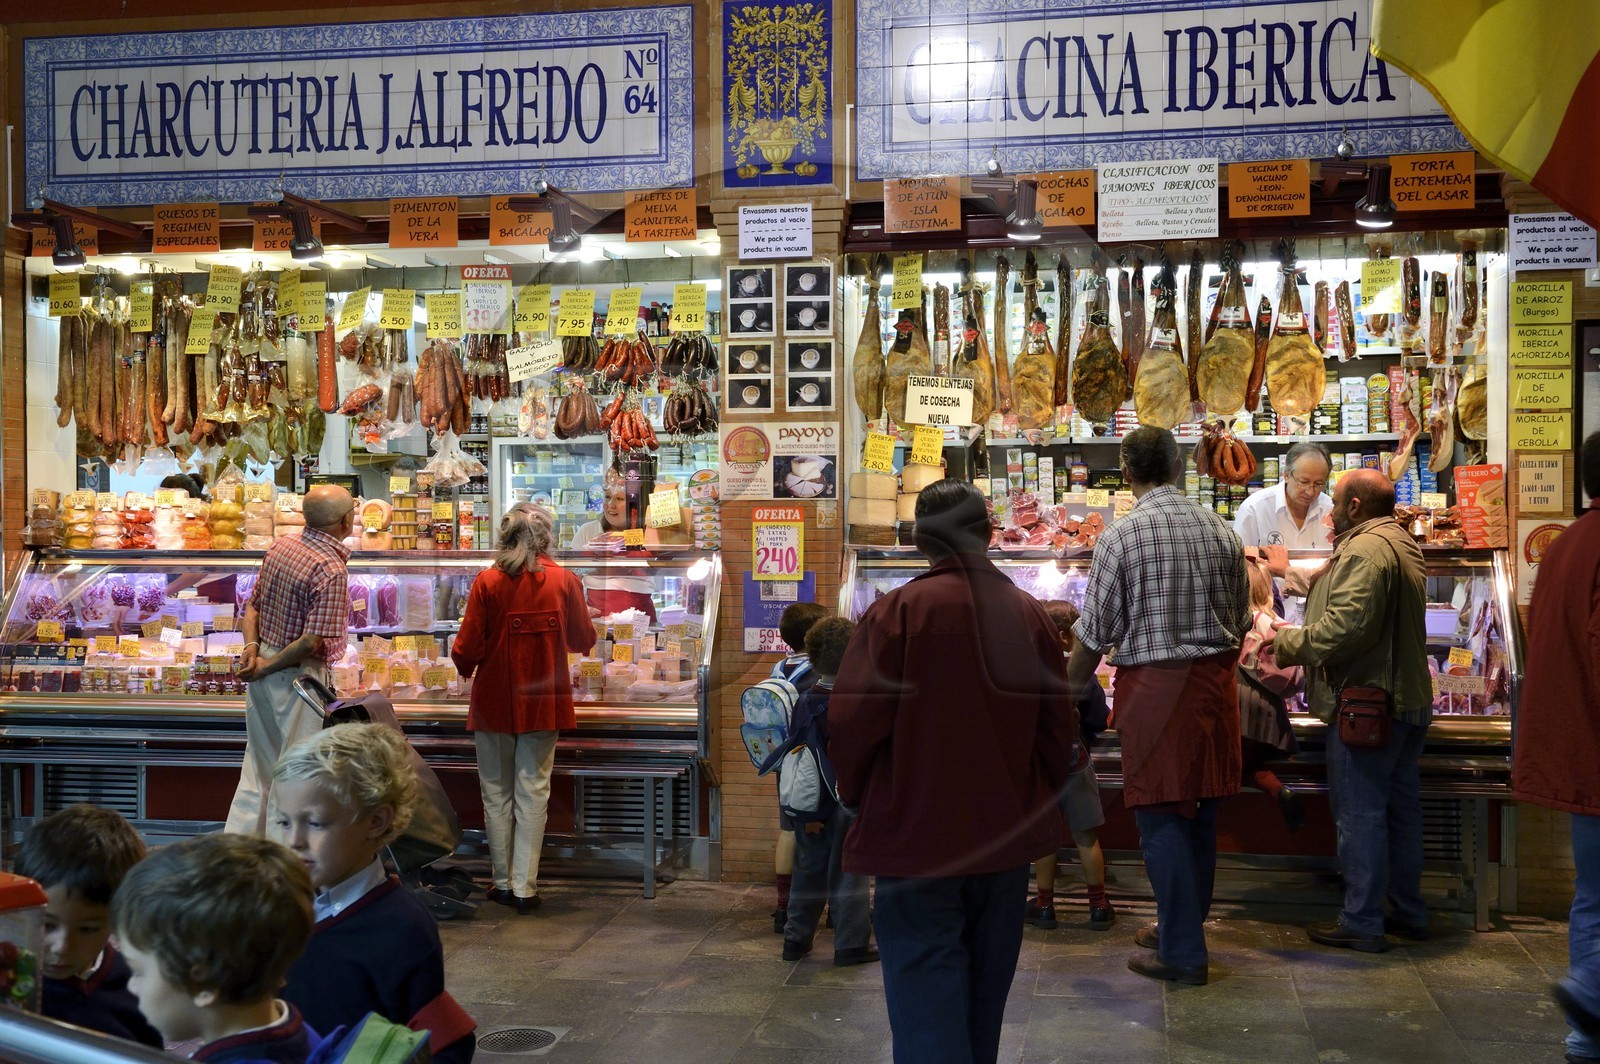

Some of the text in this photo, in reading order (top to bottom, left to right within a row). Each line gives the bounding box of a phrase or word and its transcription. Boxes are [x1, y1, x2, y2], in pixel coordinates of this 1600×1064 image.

[1164, 11, 1396, 116] IBERICA
[623, 81, 658, 114] 64
[70, 61, 607, 162] CHARCUTERIA J.ALFREDO
[1103, 163, 1216, 179] CLASIFICACION DE
[1247, 163, 1294, 174] CECINA DE
[1409, 160, 1456, 172] TORTA
[898, 177, 948, 190] MOJAMA
[1252, 174, 1289, 182] VACUNO
[1393, 172, 1473, 188] EXTREMEÑA
[1100, 179, 1217, 195] JAMONES IBERICOS
[634, 190, 690, 203] FILETES DE
[898, 191, 948, 203] DE ATUN
[1047, 193, 1065, 204] DE
[1135, 193, 1212, 206] ALIMENTACION
[1235, 192, 1307, 203] DENOMINACION
[1396, 189, 1470, 202] DEL CASAR
[393, 202, 457, 213] PIMENTON
[645, 204, 678, 213] MELVA
[742, 206, 809, 215] Envasamos nuestros
[1101, 210, 1125, 218] Bellota
[1194, 206, 1217, 214] Pastos
[1247, 202, 1295, 213] DE ORIGEN
[158, 208, 217, 221] QUESOS DE
[518, 214, 533, 224] DE
[1513, 216, 1556, 224] Envasamos
[407, 216, 441, 227] DE LA
[745, 217, 778, 226] productos
[788, 216, 806, 224] vacio
[1189, 216, 1217, 225] Cereales
[162, 222, 212, 233] REGIMEN
[499, 227, 552, 238] BACALAO
[628, 226, 695, 238] LA TARIFEÑA
[1161, 228, 1183, 236] Pastos
[1189, 227, 1217, 235] Cereales
[1516, 225, 1556, 235] productos
[156, 236, 218, 247] ESPECIALES
[409, 231, 439, 242] VERA
[768, 235, 783, 244] pack
[743, 246, 773, 255] products
[1544, 245, 1563, 254] pack
[1386, 259, 1396, 267] DE
[1515, 257, 1550, 266] products
[463, 267, 509, 278] OFERTA
[1370, 268, 1391, 276] LOMO
[1367, 276, 1396, 285] IBERICA
[1516, 283, 1566, 293] MORCILLA
[206, 294, 232, 305] 28.90
[892, 289, 915, 300] 12.60
[1516, 294, 1563, 305] DE ARROZ
[50, 300, 74, 310] 10.60
[674, 313, 699, 323] 4.81
[1522, 307, 1560, 318] (Burgos)
[300, 314, 319, 326] 6.20
[380, 316, 406, 326] 6.50
[559, 319, 585, 329] 7.95
[607, 317, 630, 327] 6.40
[1517, 328, 1564, 338] MORCILLA
[508, 340, 553, 356] GAZPACHO
[1521, 340, 1560, 349] IBERICA
[1510, 351, 1571, 360] ACHORIZADA
[508, 353, 559, 372] SALMOREJO
[518, 363, 551, 376] FRESCO
[1516, 371, 1565, 381] MORCILLA
[908, 376, 974, 390] TENEMOS LENTEJAS
[1532, 383, 1545, 393] DE
[919, 394, 961, 408] DE COSECHA
[1520, 394, 1560, 404] HIGADO
[927, 413, 950, 425] NUEVA
[1515, 414, 1564, 425] MORCILLA
[918, 427, 941, 436] OFERTA
[1532, 426, 1545, 436] DE
[870, 433, 892, 443] OFERTA
[1517, 438, 1560, 448] CEBOLLA
[863, 459, 884, 470] 7.80
[911, 454, 933, 464] 9.80
[1467, 470, 1489, 478] TEJERO
[754, 508, 802, 520] OFERTA
